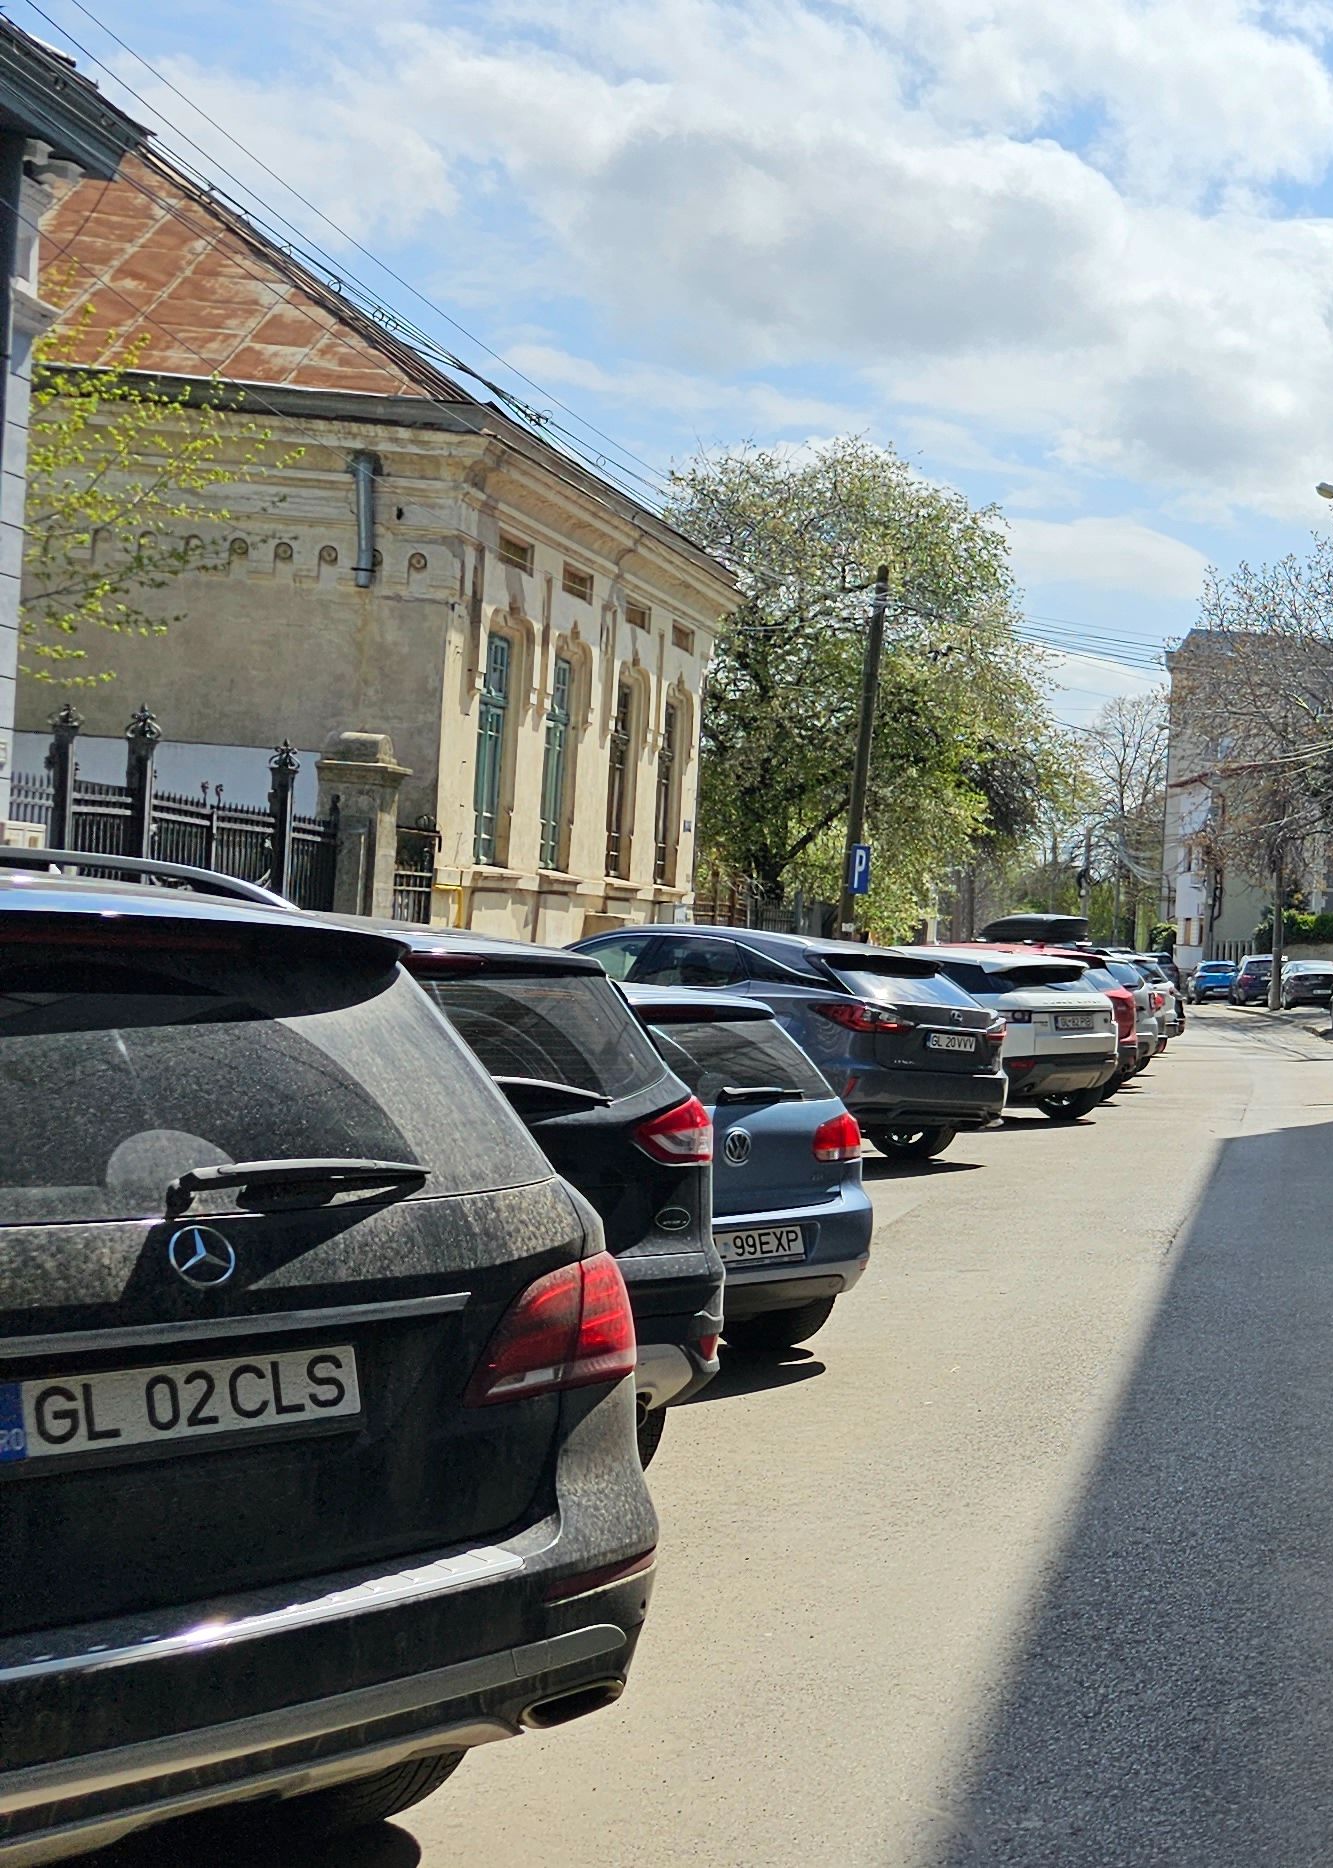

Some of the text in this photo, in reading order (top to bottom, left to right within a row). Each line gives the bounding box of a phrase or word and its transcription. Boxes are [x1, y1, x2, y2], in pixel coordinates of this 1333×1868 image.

[853, 849, 866, 889] P
[932, 1035, 942, 1047] GL
[34, 1383, 121, 1444] GL
